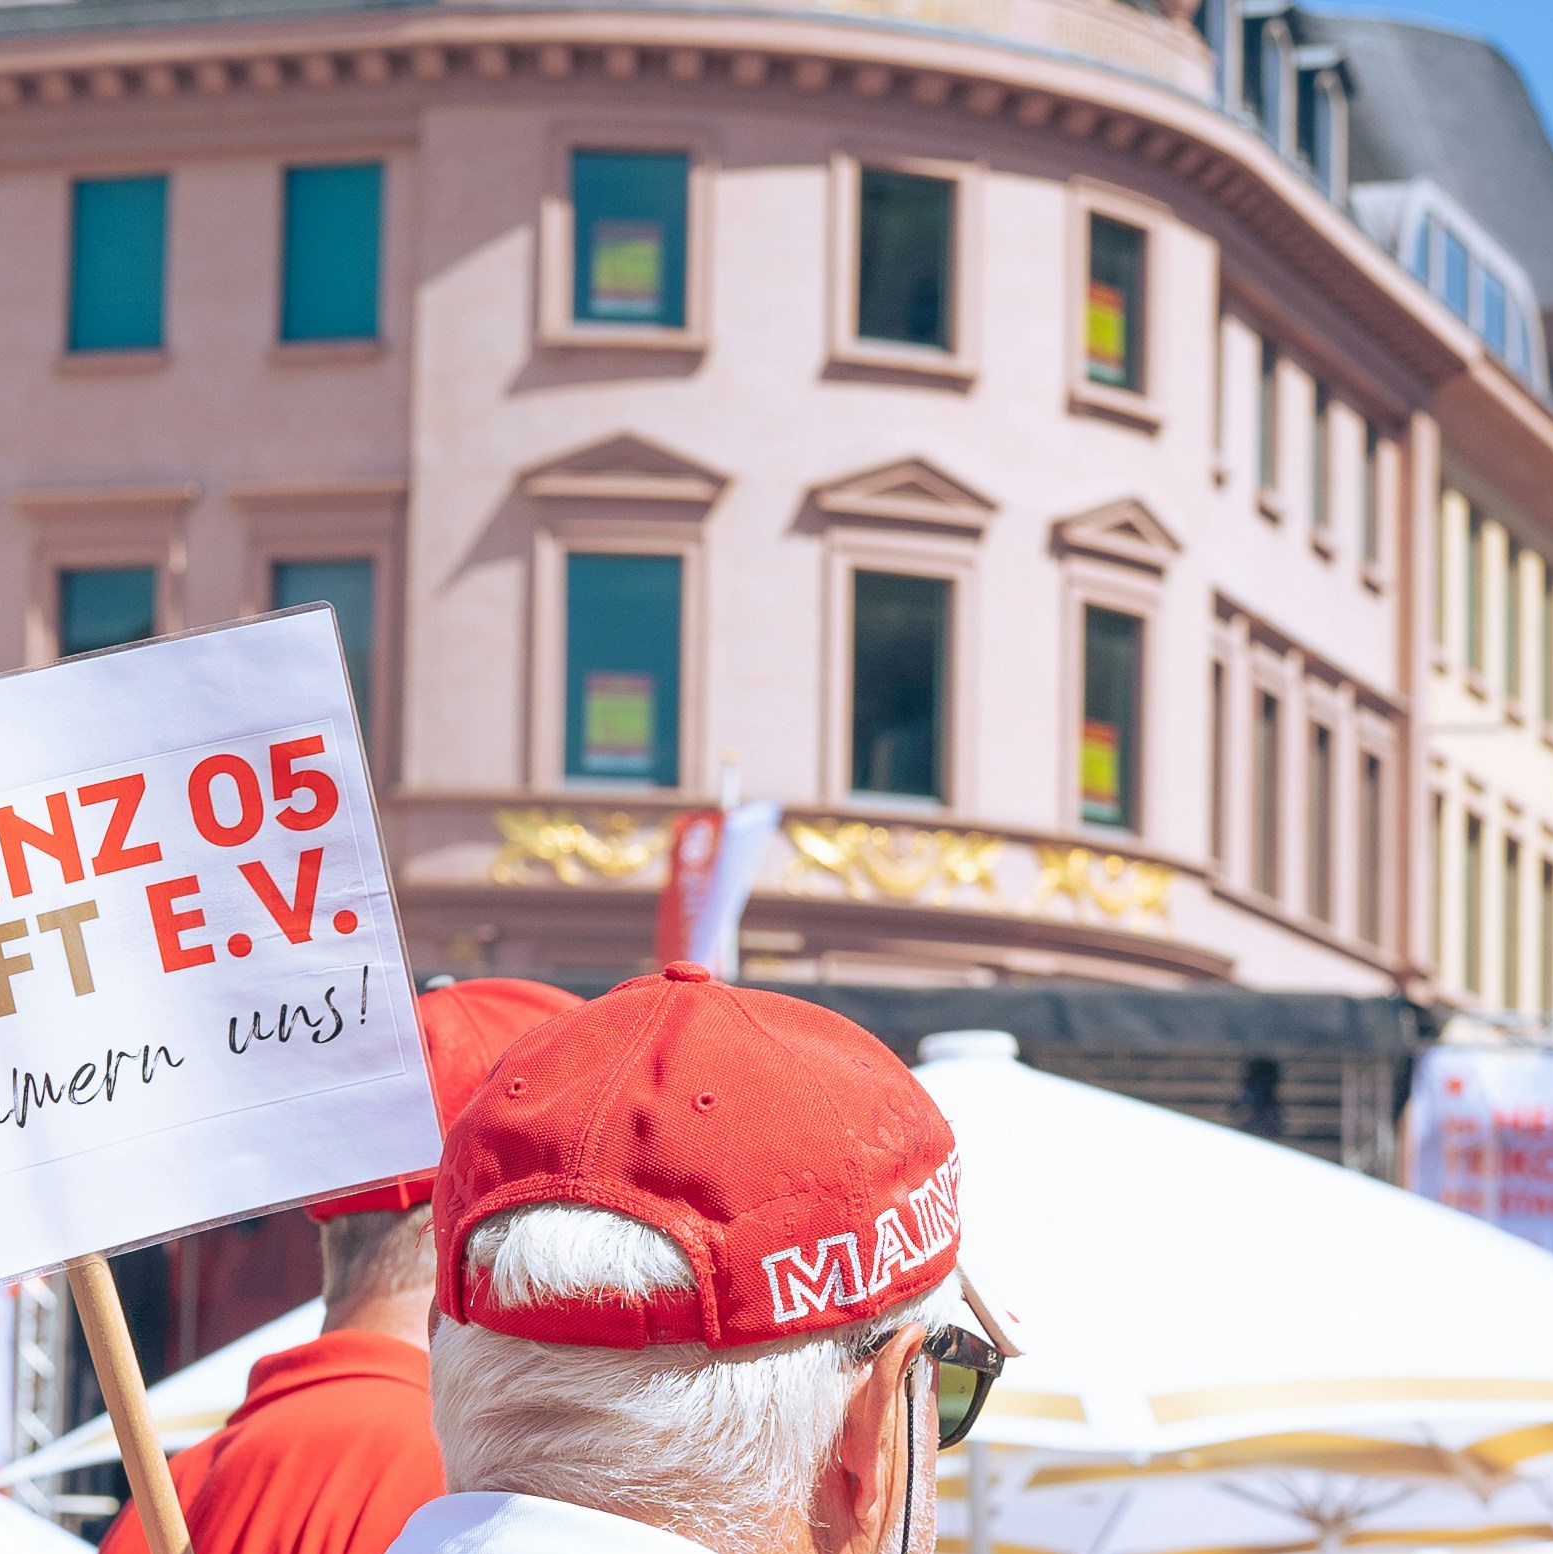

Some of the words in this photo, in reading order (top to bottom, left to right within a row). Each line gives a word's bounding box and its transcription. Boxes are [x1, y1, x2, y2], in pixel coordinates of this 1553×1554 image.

[187, 734, 340, 849] 05
[145, 847, 360, 975] E.V.
[227, 965, 370, 1055] uns!
